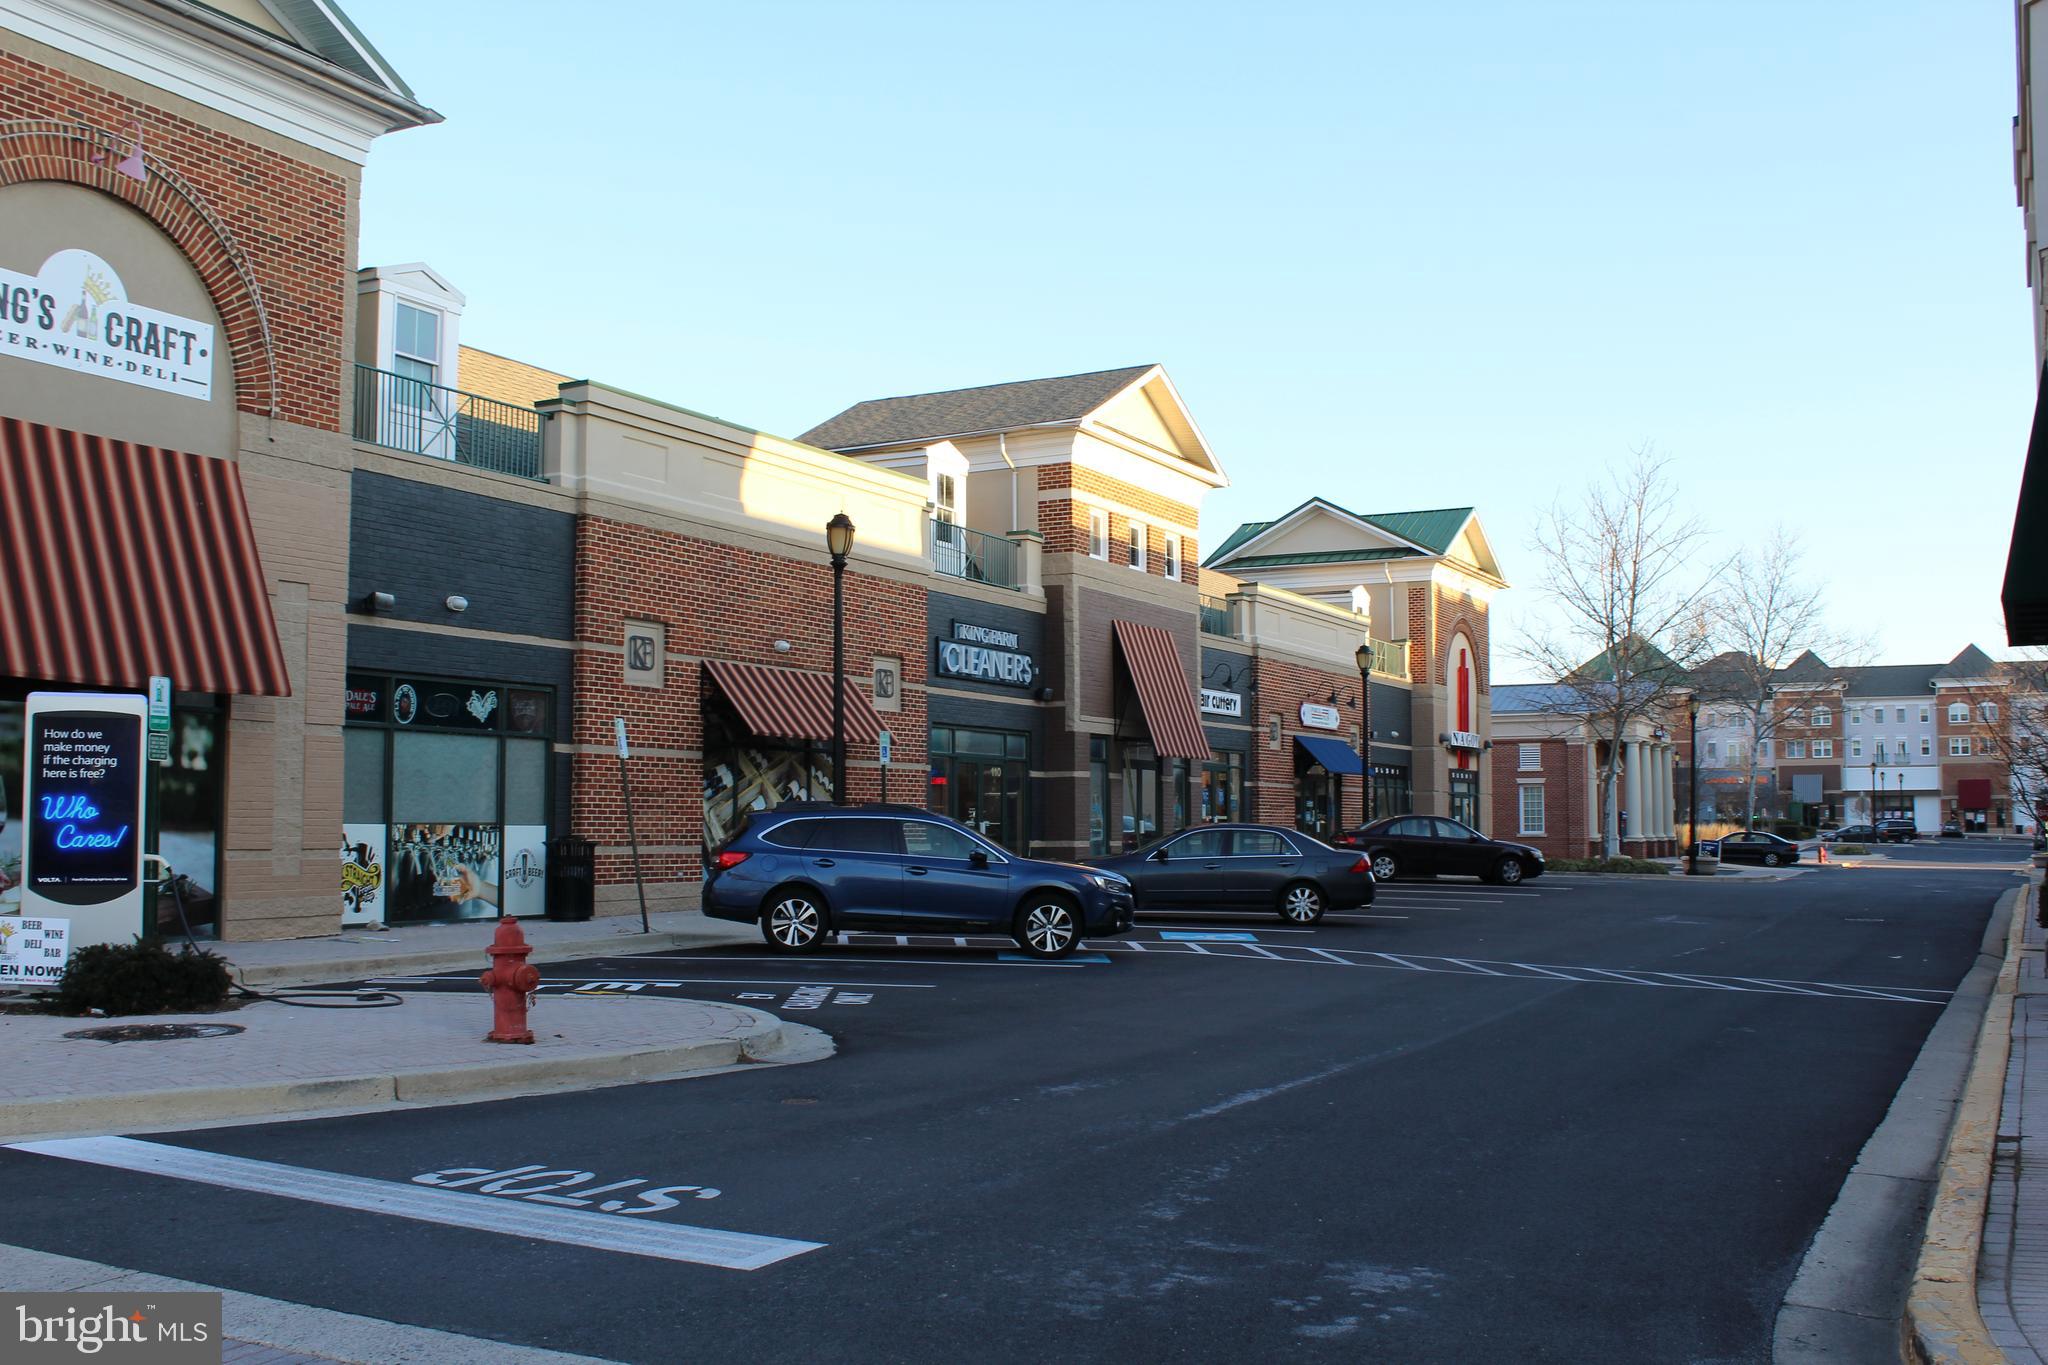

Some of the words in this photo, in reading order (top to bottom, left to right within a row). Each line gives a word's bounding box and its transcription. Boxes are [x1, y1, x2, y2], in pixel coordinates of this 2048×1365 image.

[105, 311, 197, 366] CRAFT
[0, 329, 38, 350] ER
[52, 343, 114, 367] WINE
[125, 361, 178, 383] DELI
[946, 643, 1033, 684] CLEANERS
[1212, 695, 1237, 711] cuttery
[44, 728, 69, 738] How
[71, 728, 85, 739] do
[87, 731, 103, 739] we
[43, 742, 73, 752] make
[74, 744, 111, 754] money
[43, 755, 51, 765] if
[52, 755, 70, 765] the
[72, 755, 117, 768] charging
[42, 767, 67, 778] here
[69, 768, 77, 778] is
[79, 767, 106, 778] free?
[41, 795, 100, 820] Who
[56, 824, 129, 849] Cares!
[22, 920, 42, 930] BEER
[44, 929, 64, 939] WINE
[24, 939, 42, 949] DELI
[44, 947, 61, 957] BAR
[0, 964, 19, 976] EN
[410, 1164, 722, 1215] STOP
